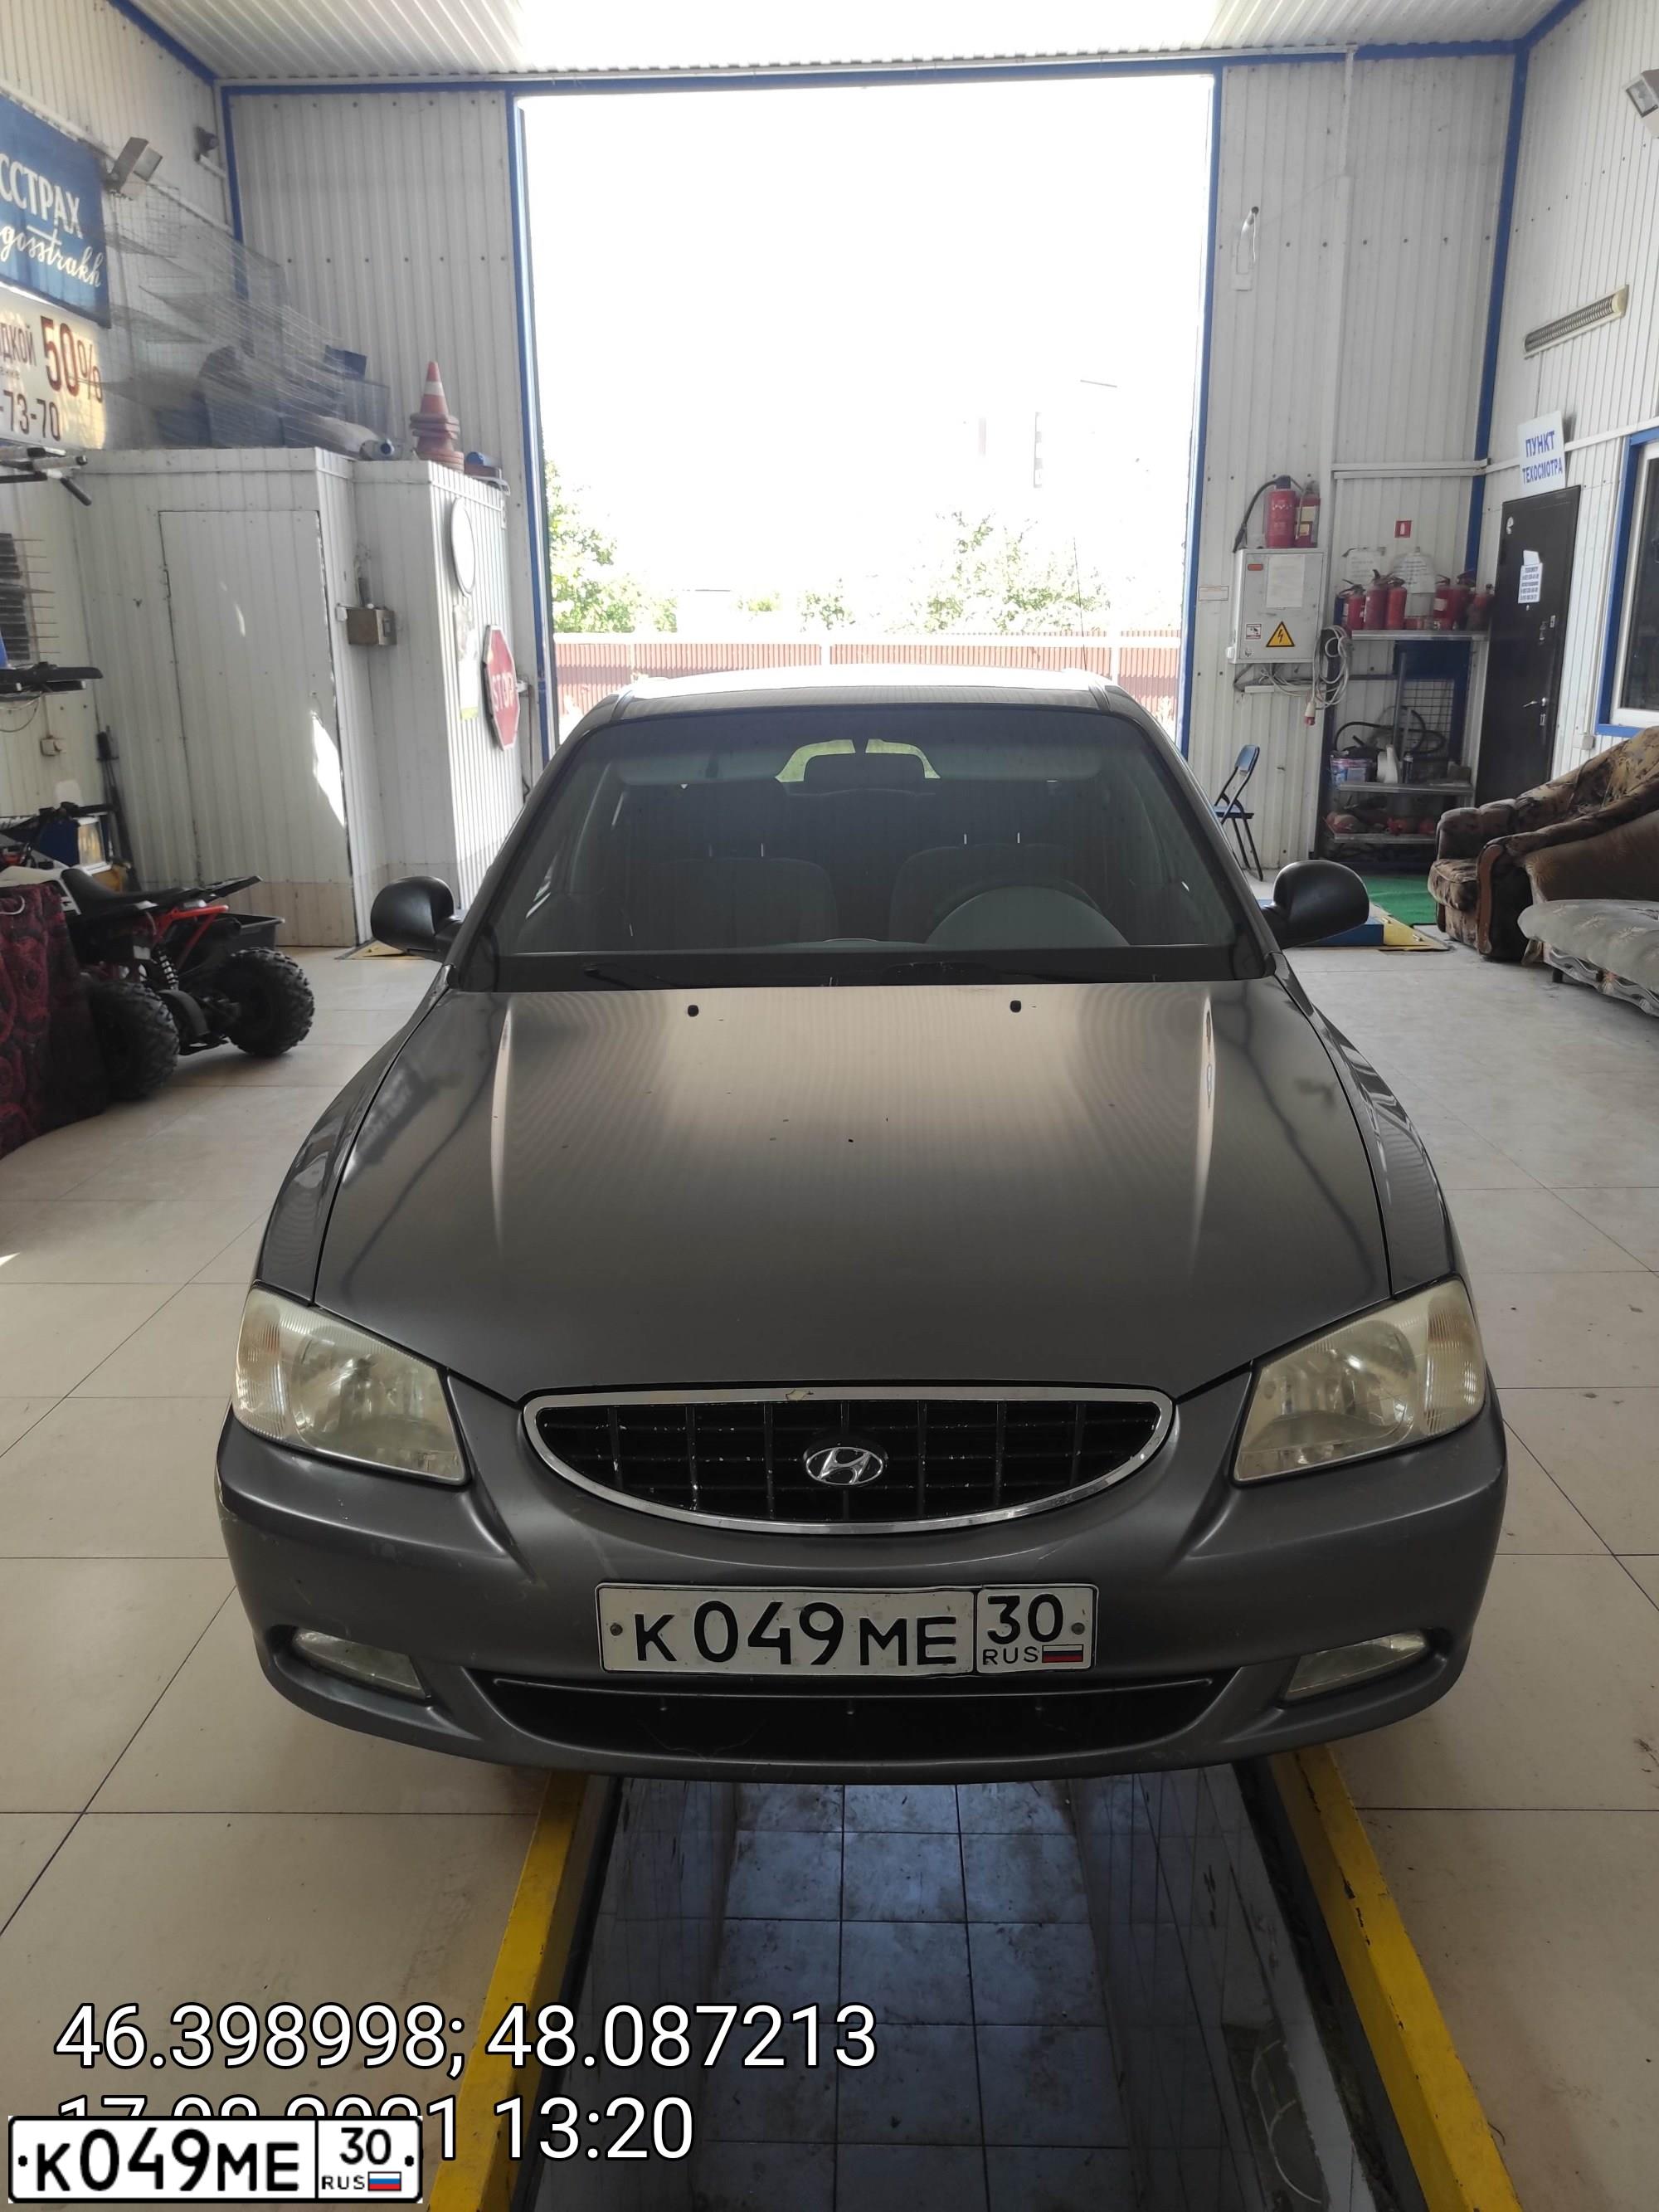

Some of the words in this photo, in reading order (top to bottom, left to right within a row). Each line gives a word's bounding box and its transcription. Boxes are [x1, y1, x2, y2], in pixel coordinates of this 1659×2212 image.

[41, 314, 103, 404] 50%
[1525, 430, 1554, 458] ПУНКТ
[1522, 457, 1564, 485] ТЕХОСМОТРА
[492, 672, 515, 712] STOP
[635, 1600, 957, 1666] К049МЕ
[987, 1593, 1063, 1644] 30
[982, 1647, 1039, 1665] RUS
